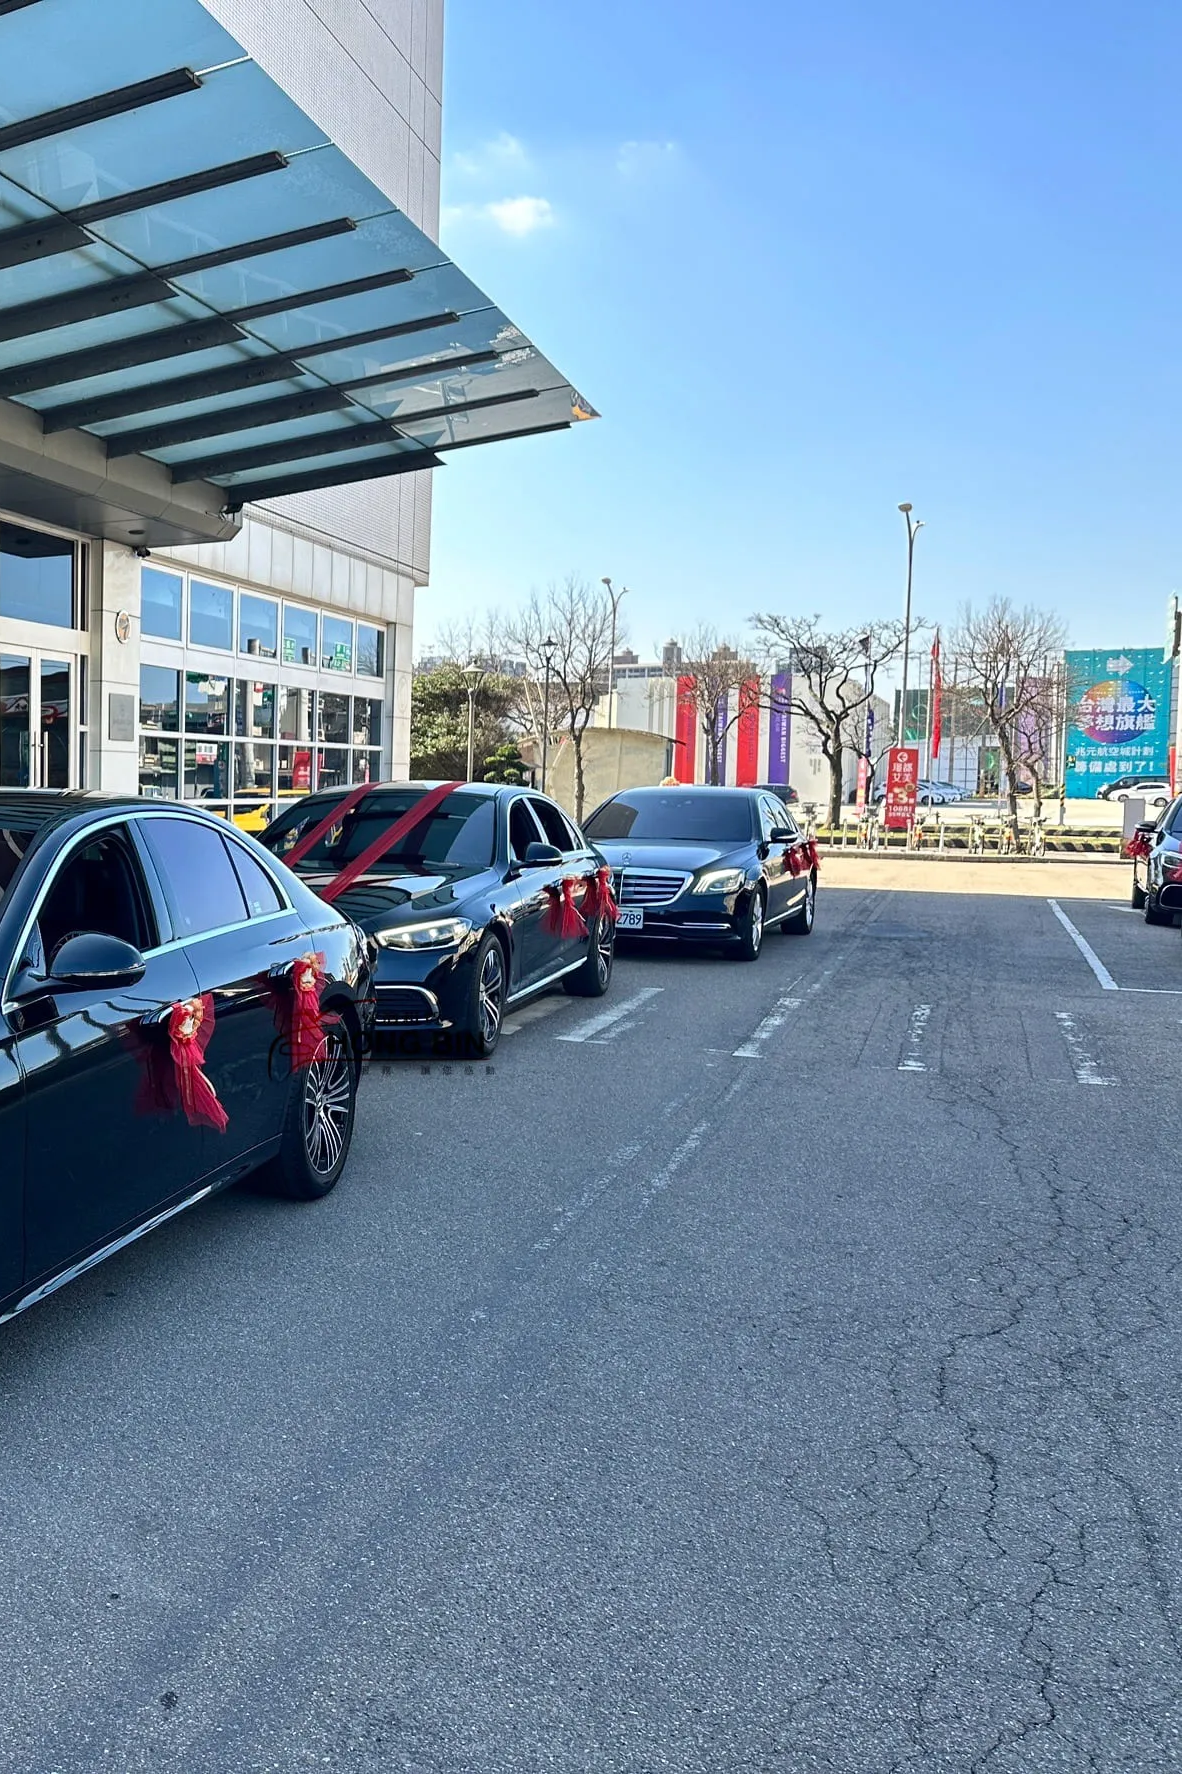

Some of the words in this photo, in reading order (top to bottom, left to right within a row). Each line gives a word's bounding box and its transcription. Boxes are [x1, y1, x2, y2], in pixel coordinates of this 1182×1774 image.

[1077, 694, 1156, 713] 台灣最大
[616, 912, 642, 926] 2789
